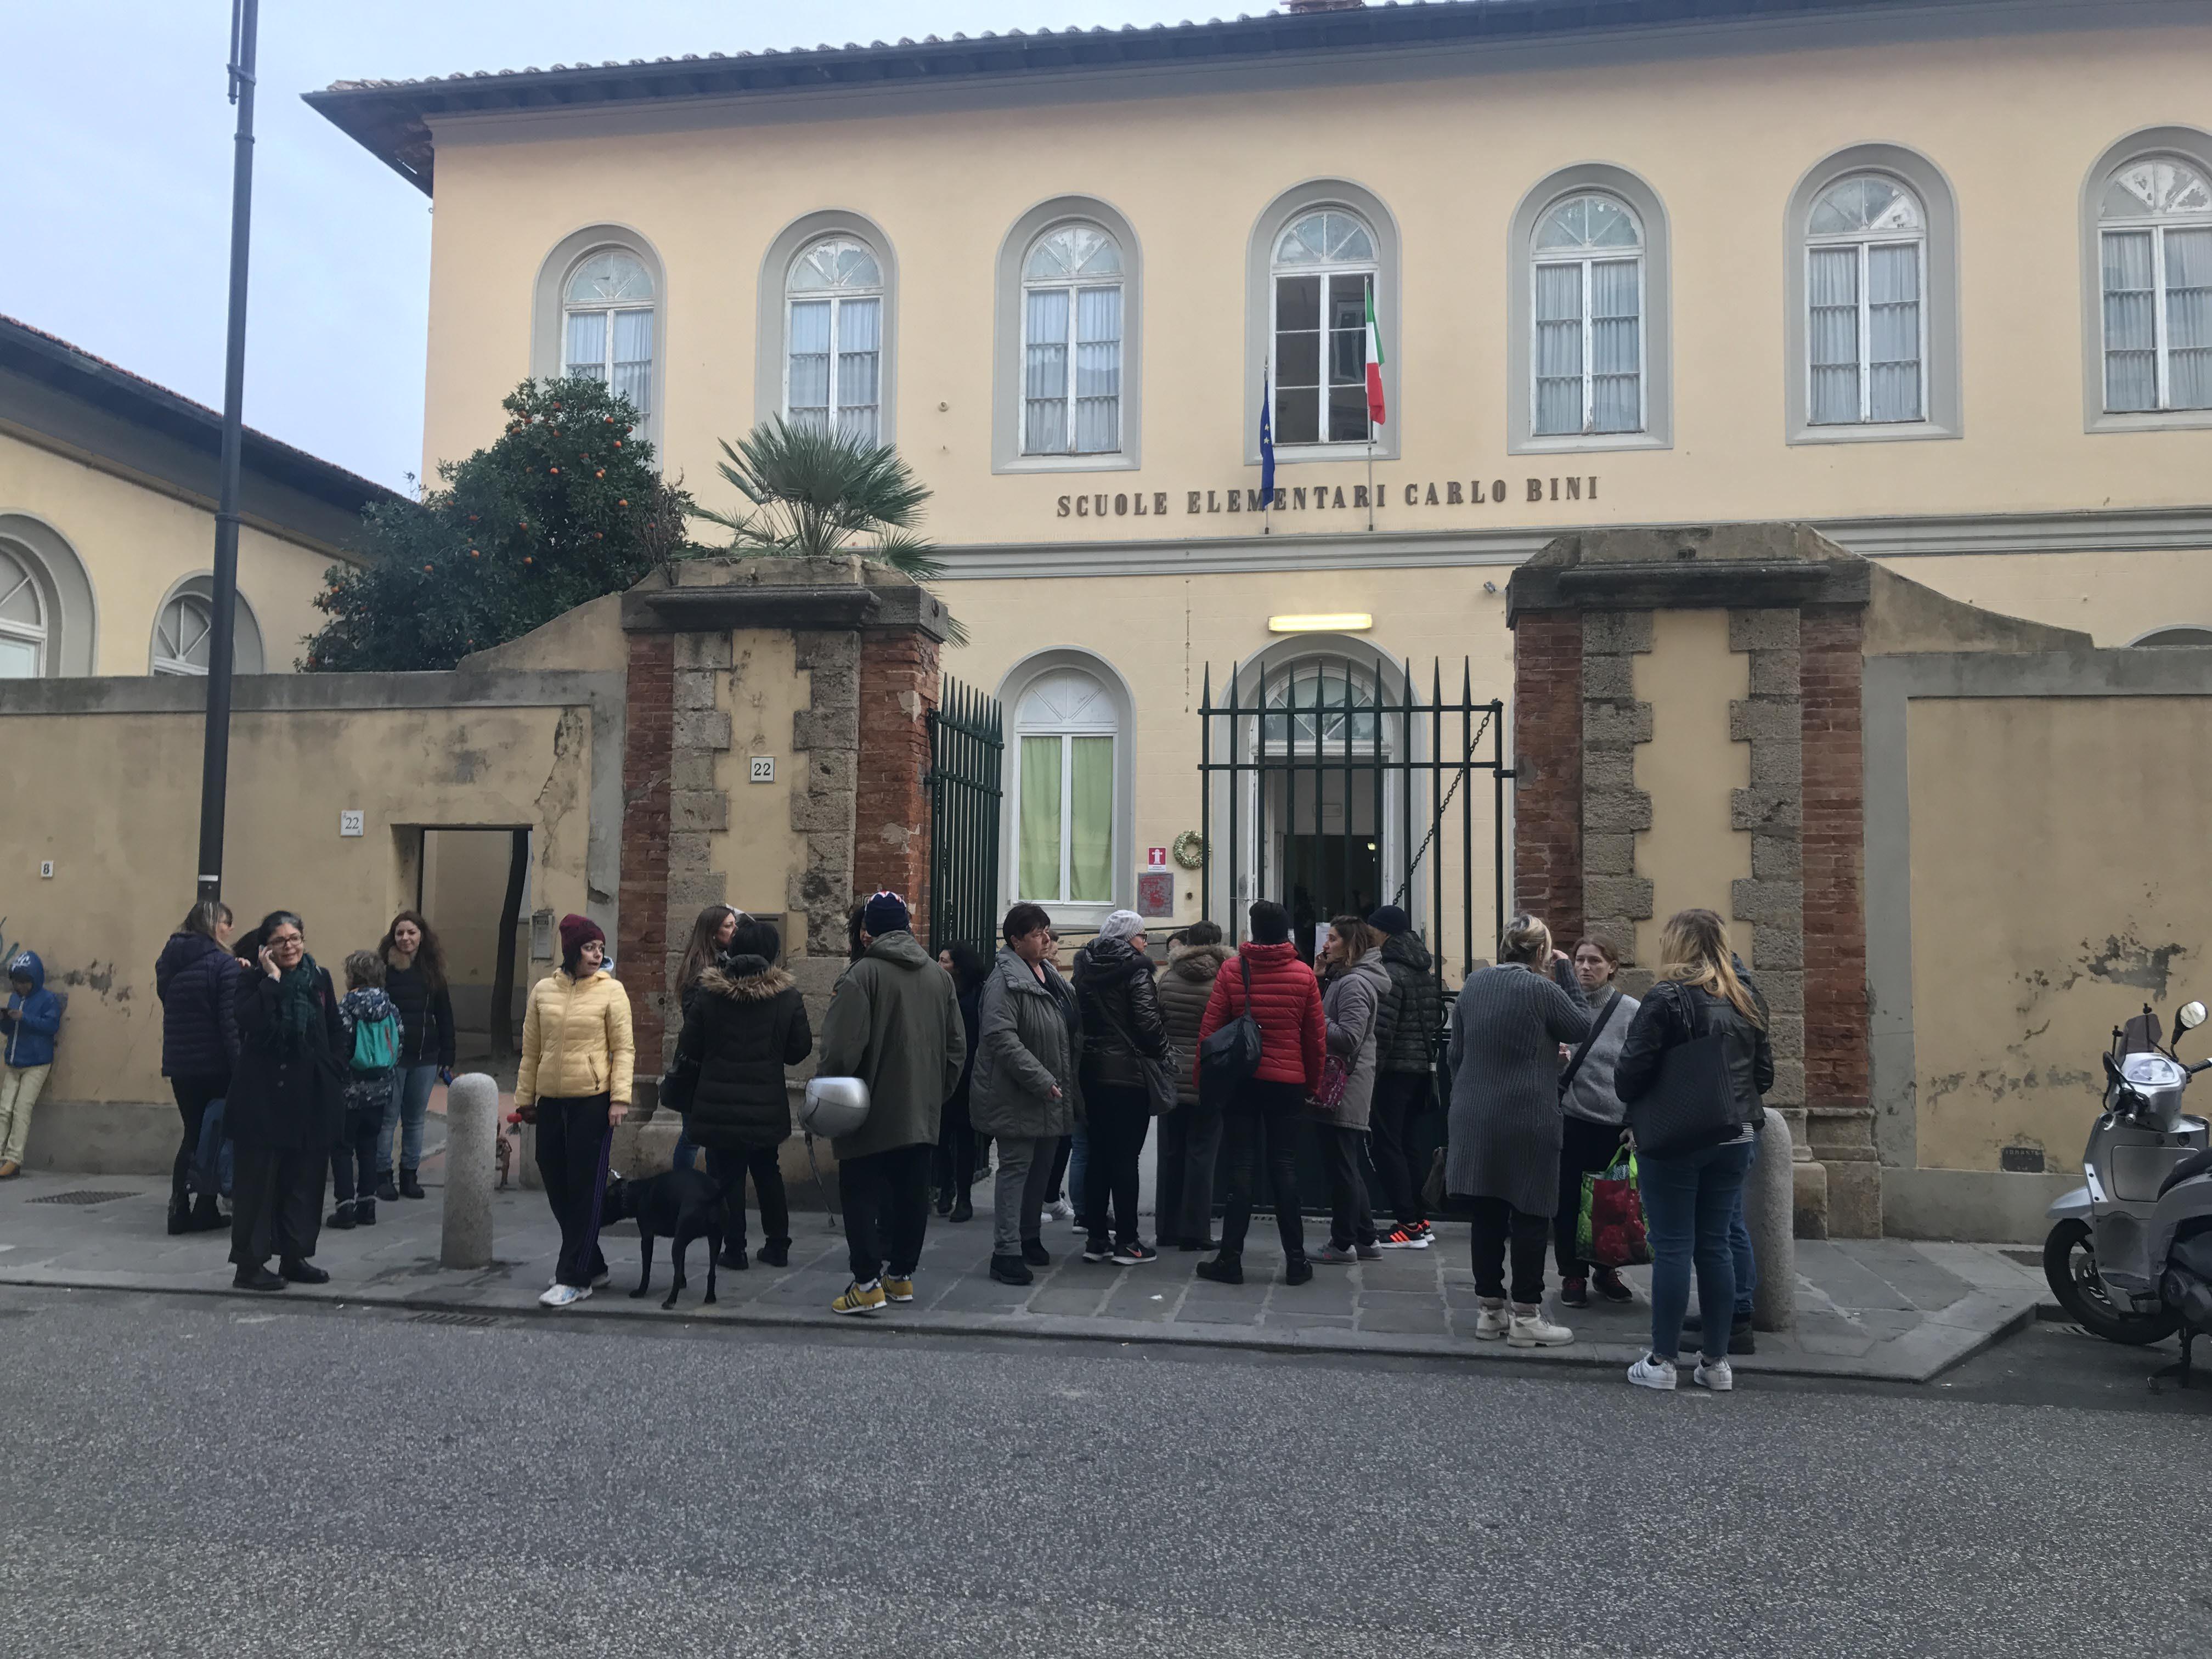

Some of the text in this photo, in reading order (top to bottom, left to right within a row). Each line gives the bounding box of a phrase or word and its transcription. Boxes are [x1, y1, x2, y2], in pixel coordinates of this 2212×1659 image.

[1057, 476, 1598, 517] SCUOLE ELEMENTARI CARLO BINI
[754, 763, 771, 776] 22
[345, 817, 359, 830] 22
[43, 863, 49, 874] 8
